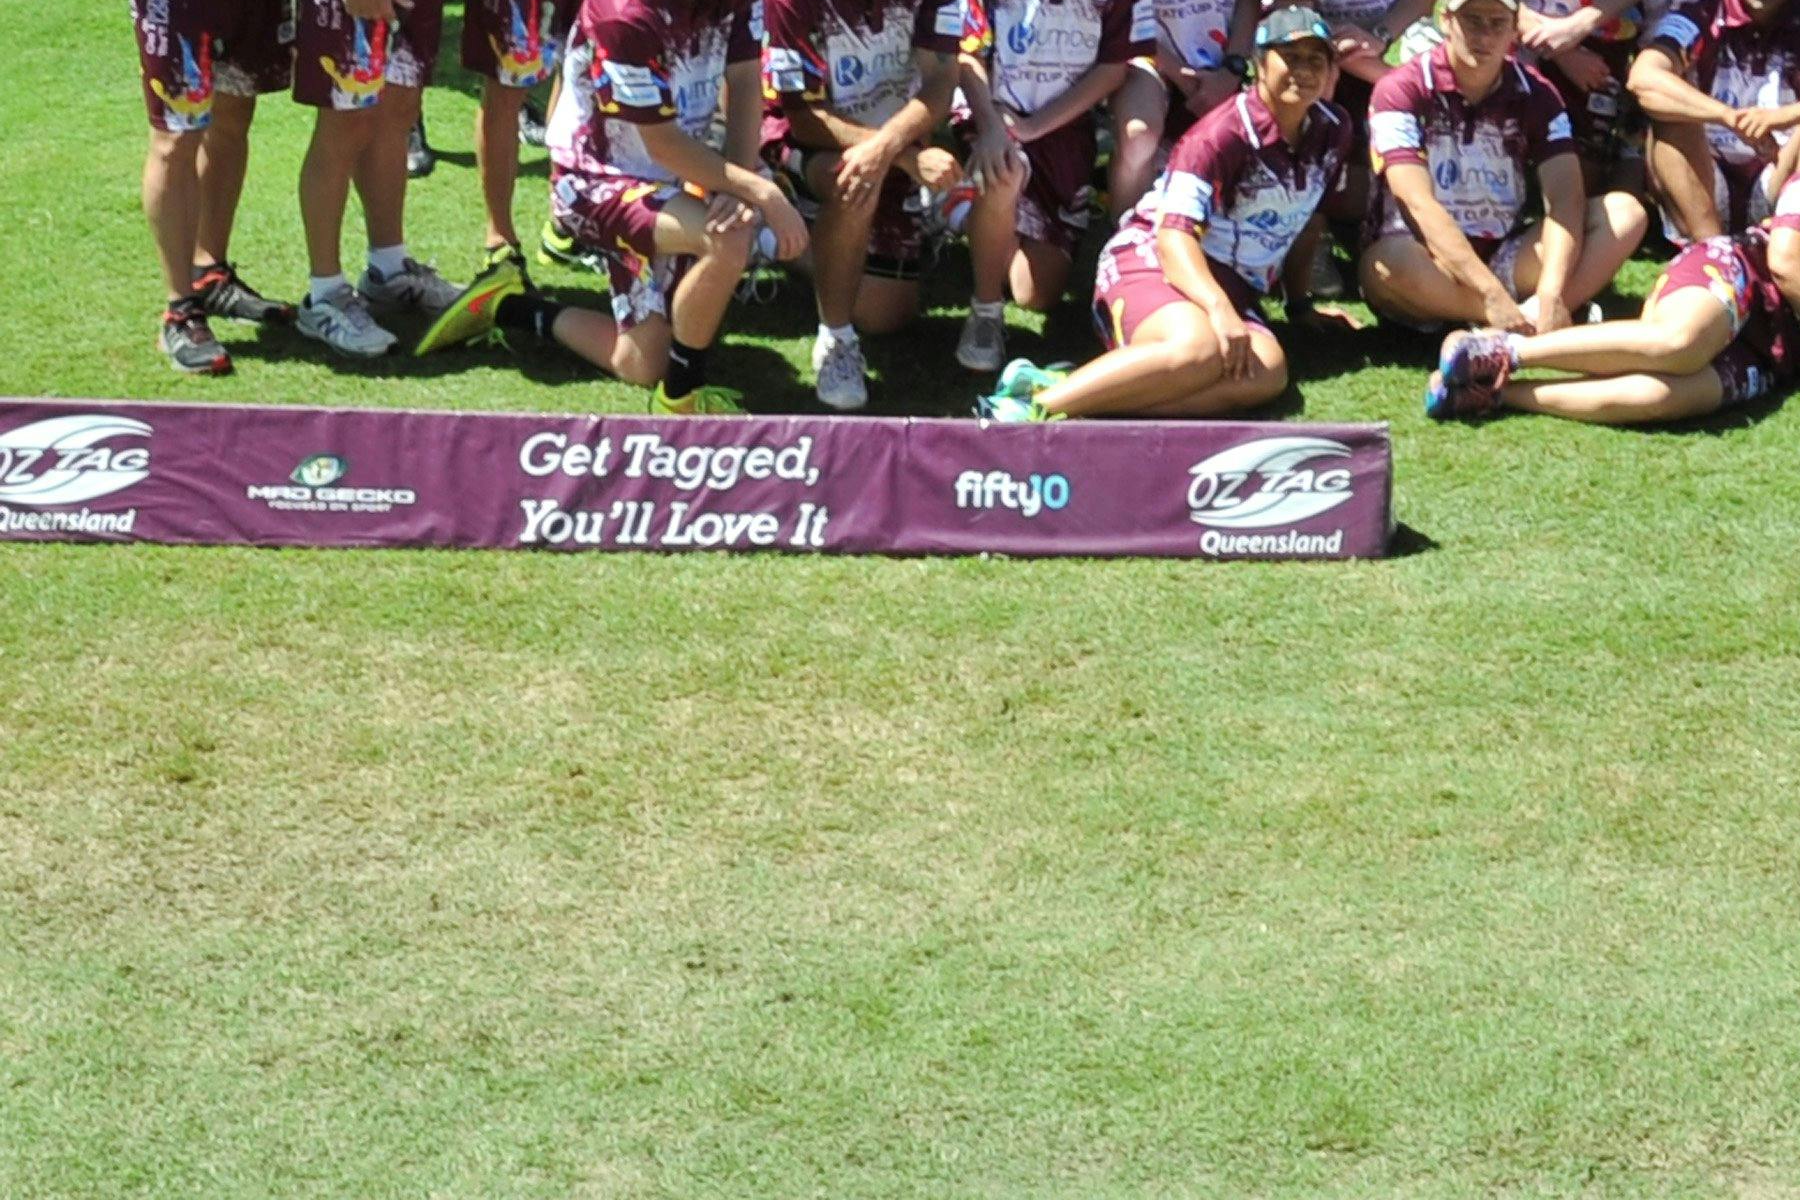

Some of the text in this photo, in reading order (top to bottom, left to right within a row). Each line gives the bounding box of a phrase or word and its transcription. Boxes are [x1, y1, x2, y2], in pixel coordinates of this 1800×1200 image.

[519, 432, 821, 490] Get Tagged,
[954, 470, 1070, 518] fifty10
[518, 500, 830, 546] You'll Love It
[1200, 528, 1344, 555] Queensland
